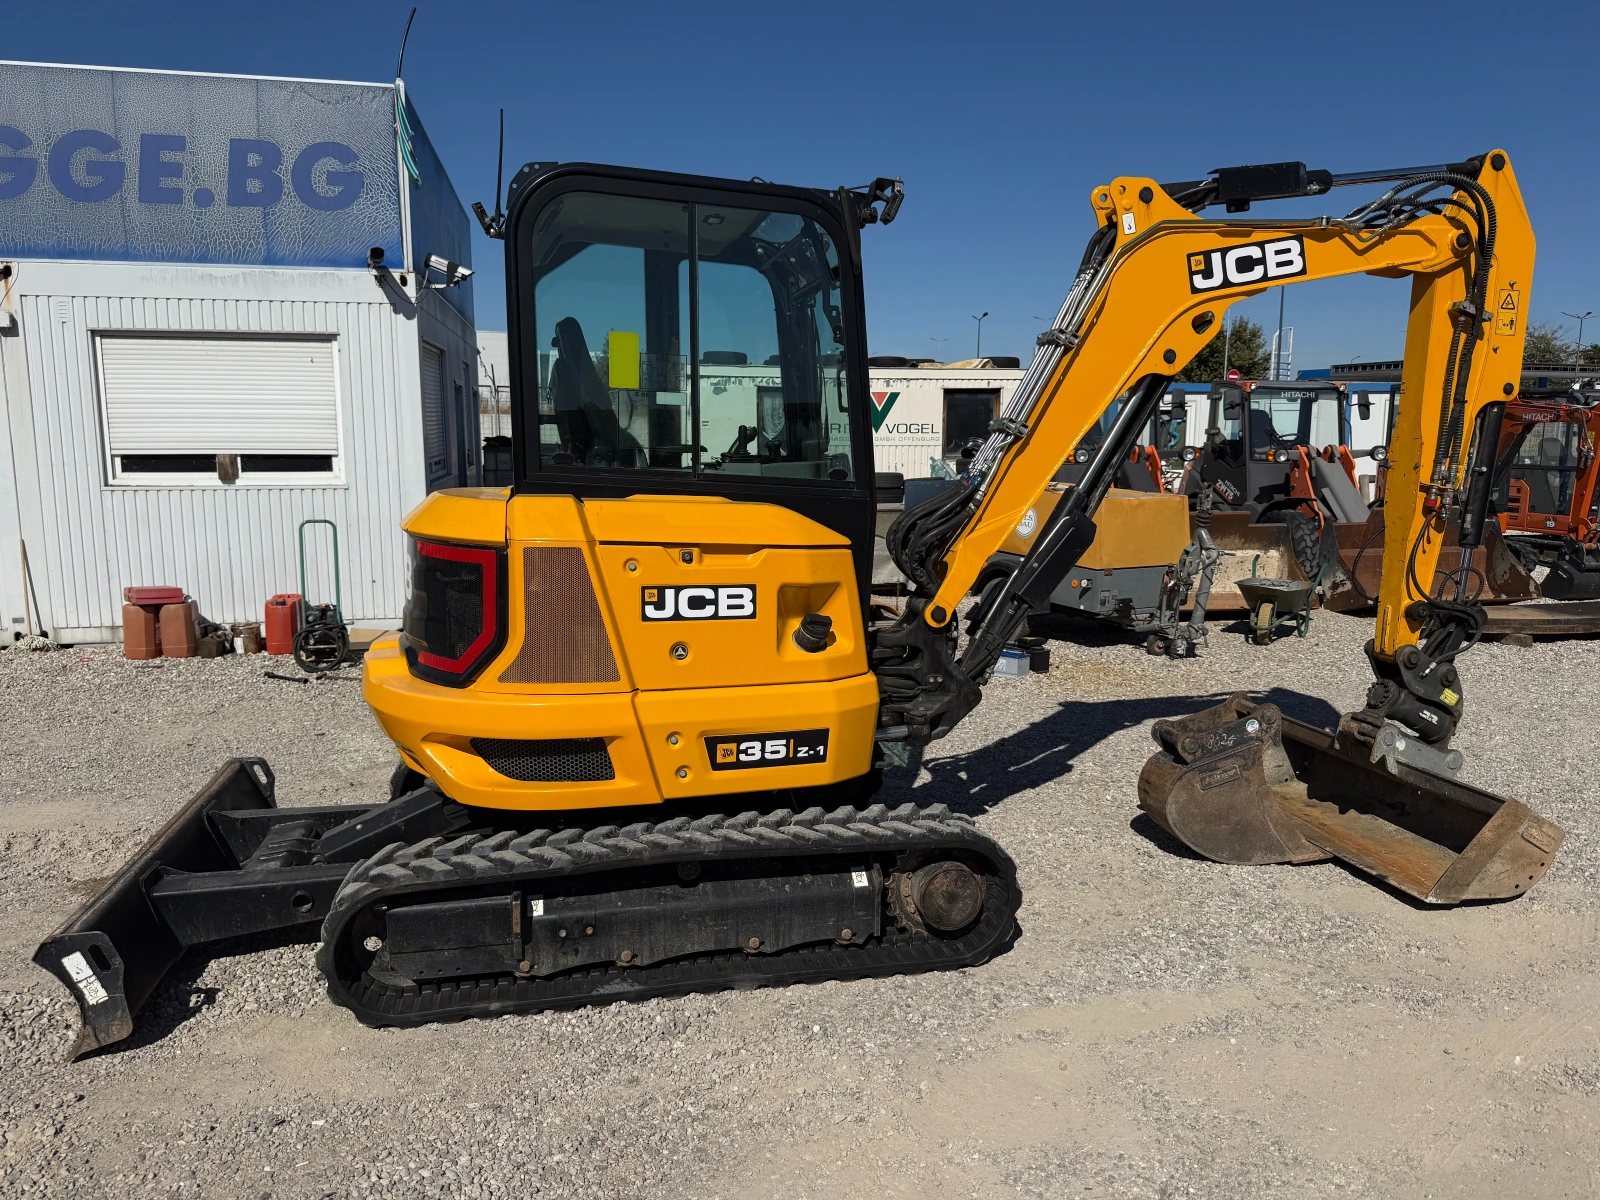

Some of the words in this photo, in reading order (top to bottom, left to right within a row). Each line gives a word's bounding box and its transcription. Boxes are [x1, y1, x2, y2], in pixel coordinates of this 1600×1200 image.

[1192, 239, 1304, 289] JCB
[885, 423, 940, 434] VOGEL
[1215, 478, 1234, 500] ZW75
[644, 587, 754, 619] JCB
[738, 739, 787, 762] 35
